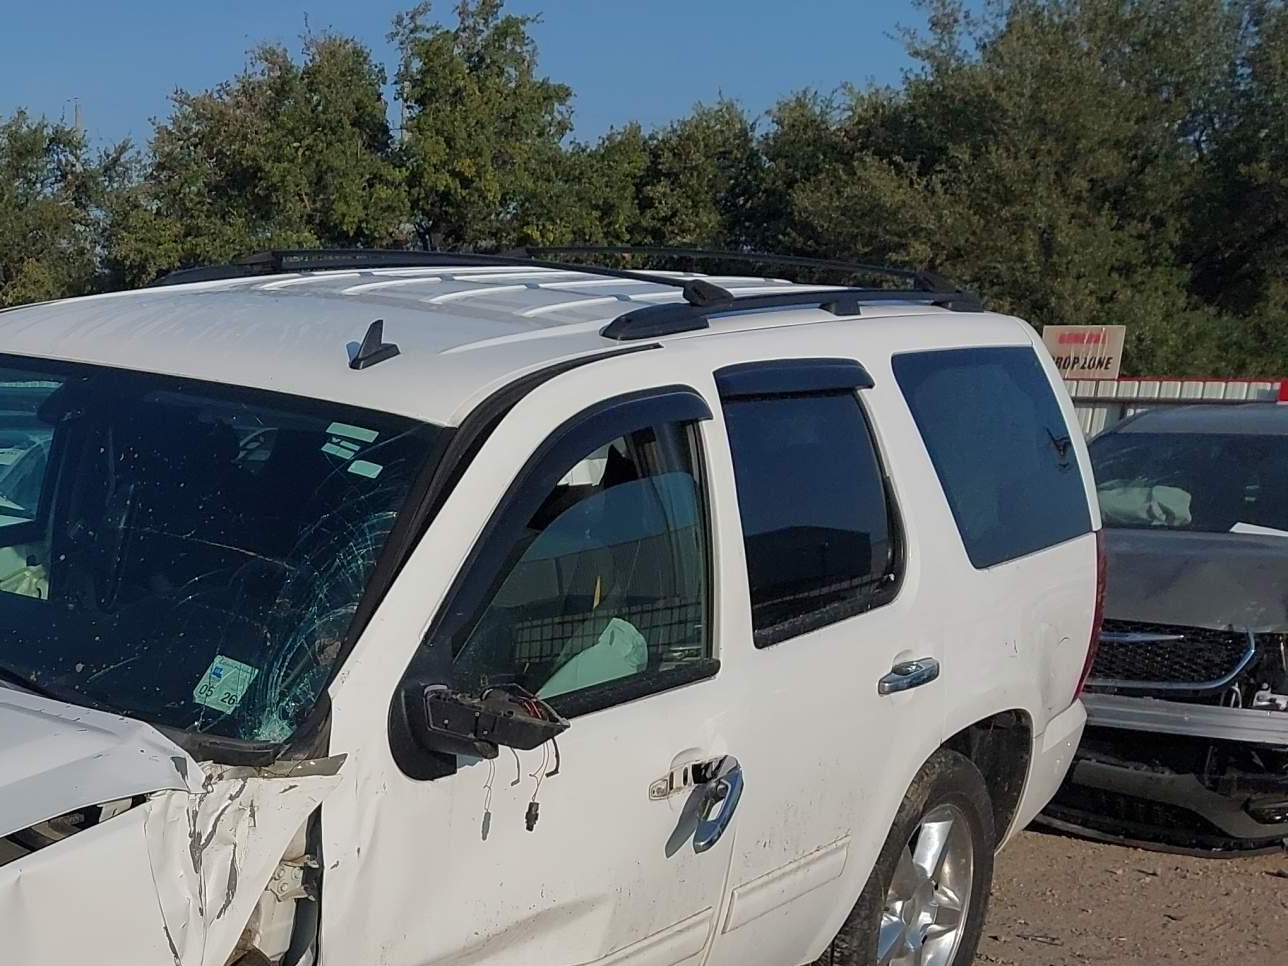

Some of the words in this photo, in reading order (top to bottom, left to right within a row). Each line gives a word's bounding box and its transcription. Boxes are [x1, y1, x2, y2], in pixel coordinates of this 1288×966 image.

[1080, 355, 1113, 370] ZONE
[199, 684, 215, 697] 05
[221, 692, 238, 705] 26
